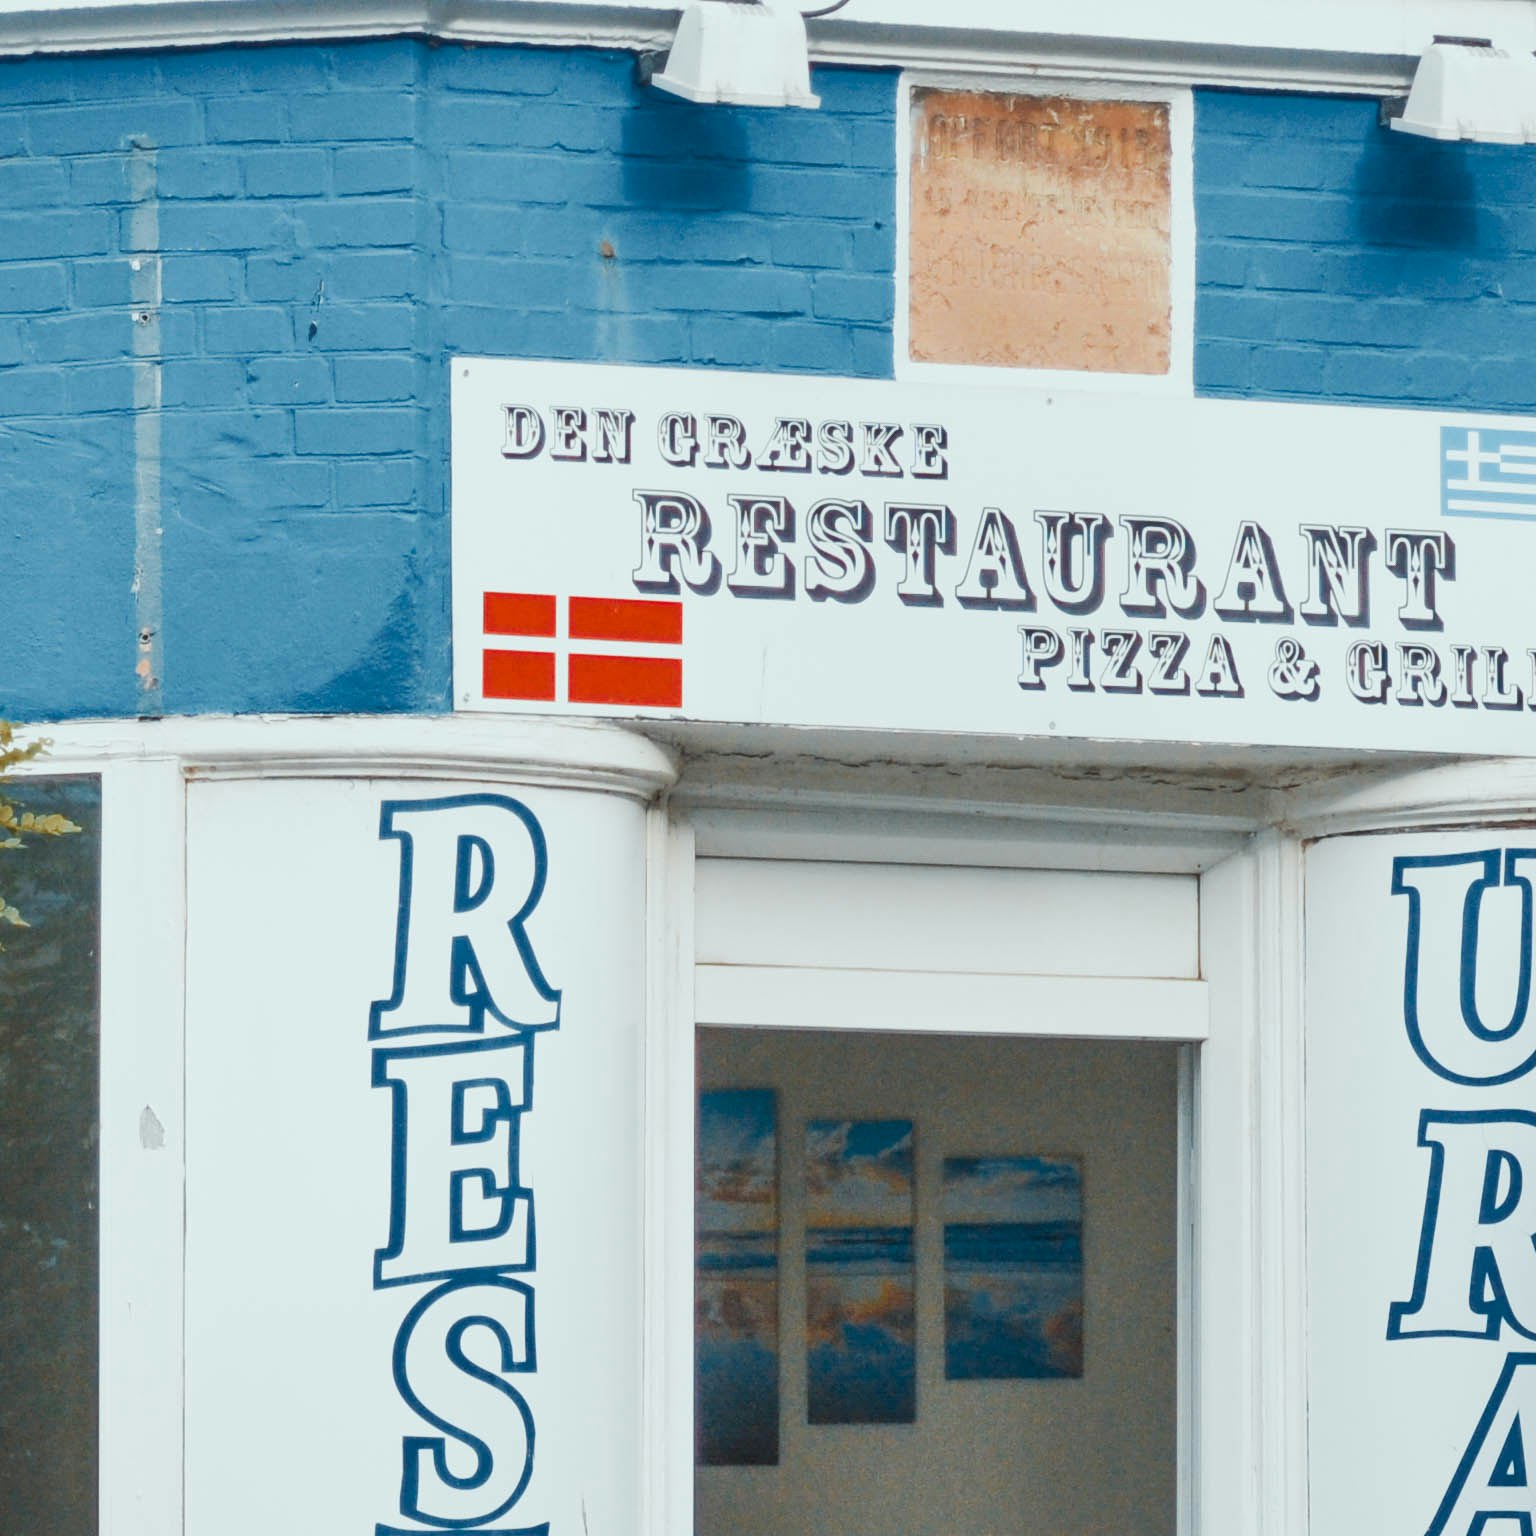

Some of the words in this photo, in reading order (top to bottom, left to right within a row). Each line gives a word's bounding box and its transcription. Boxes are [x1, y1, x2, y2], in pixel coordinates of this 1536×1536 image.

[500, 405, 634, 463] DEN
[658, 409, 949, 481] GRÆSKE
[632, 488, 1457, 629] RESTAURANT
[1017, 624, 1245, 699] PIZZA
[1269, 637, 1321, 702] &
